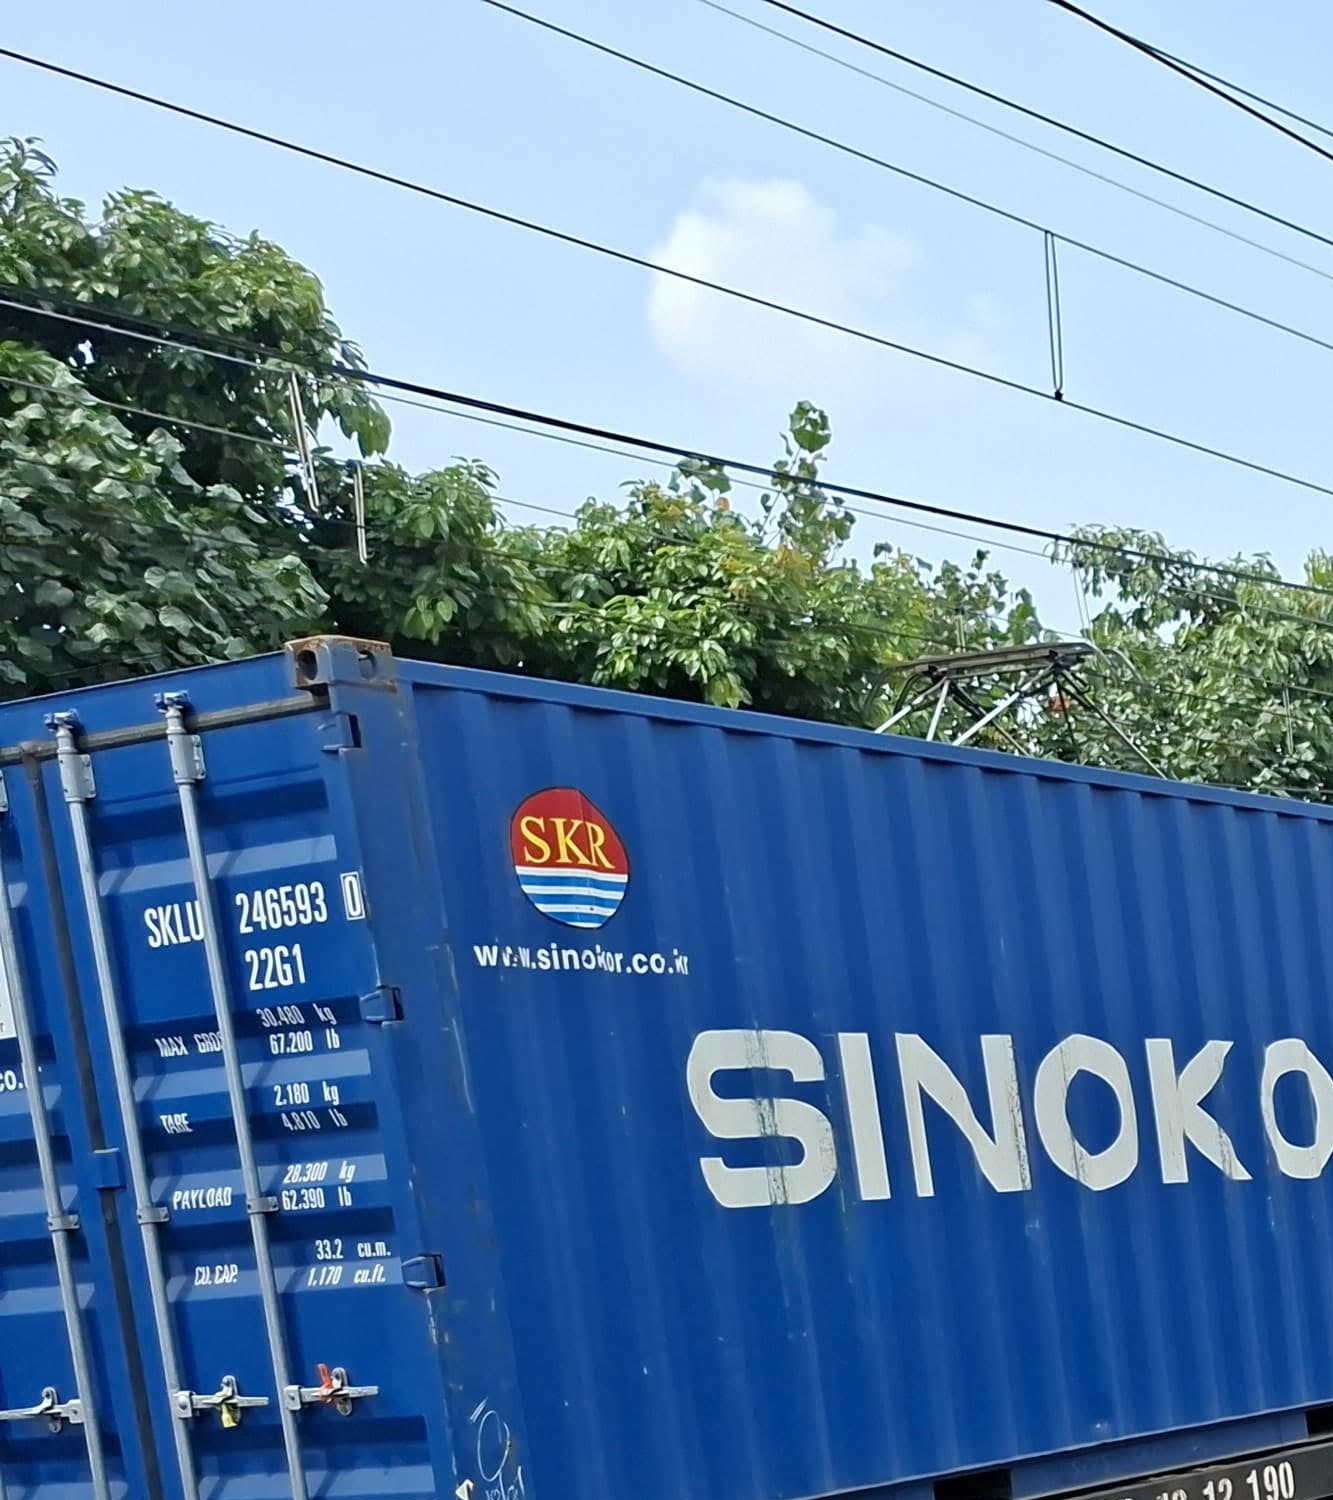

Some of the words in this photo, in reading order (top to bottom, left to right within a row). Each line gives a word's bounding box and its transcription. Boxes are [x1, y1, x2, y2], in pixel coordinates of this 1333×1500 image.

[520, 815, 616, 869] SKR
[144, 900, 206, 949] SKLU
[235, 881, 328, 935] 246593
[344, 875, 362, 918] 0
[245, 943, 306, 992] 22G1
[256, 1005, 306, 1028] 30.480
[312, 1003, 337, 1026] kg
[155, 1035, 188, 1058] MAX
[269, 1030, 314, 1056] 67.200
[325, 1028, 341, 1049] lb
[273, 1082, 311, 1107] 2.180
[322, 1080, 340, 1106] kg
[160, 1113, 194, 1135] TARE
[281, 1110, 322, 1132] 4.810
[328, 1107, 349, 1128] lb
[283, 1161, 329, 1185] 28.300
[338, 1160, 356, 1183] kg
[172, 1187, 233, 1211] PAYLOAD
[281, 1187, 326, 1211] 62.390
[337, 1186, 353, 1207] lb
[315, 1238, 344, 1261] 33.2
[357, 1240, 392, 1258] cu.m.
[307, 1266, 343, 1288] 1.170
[353, 1263, 387, 1285] cu.ft.
